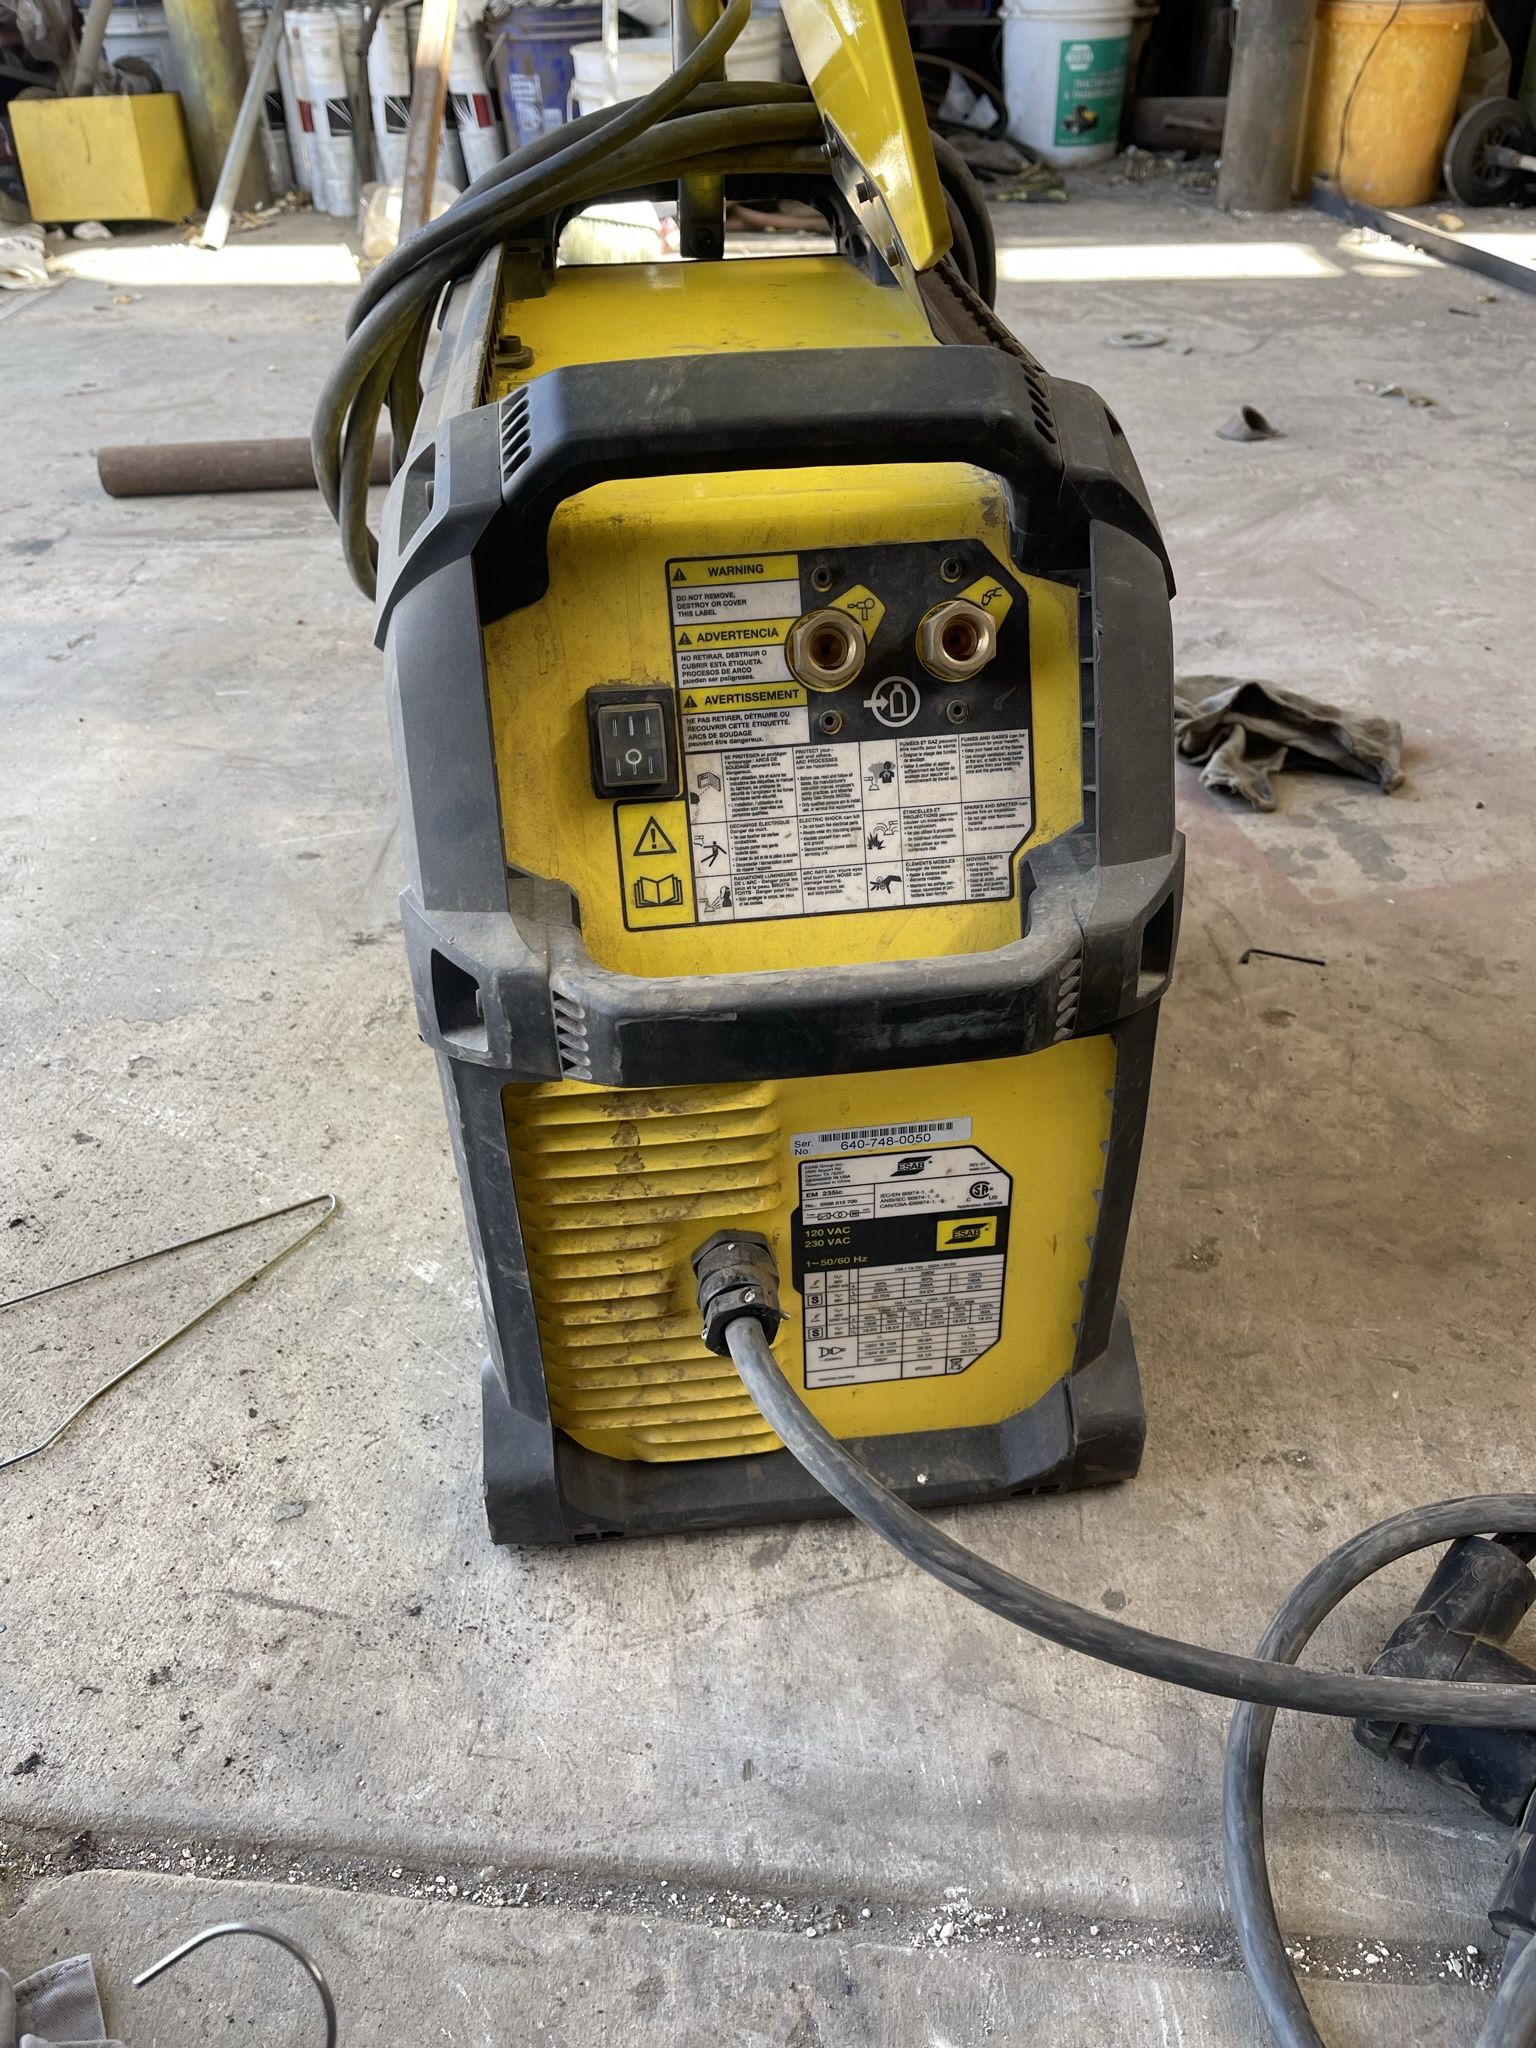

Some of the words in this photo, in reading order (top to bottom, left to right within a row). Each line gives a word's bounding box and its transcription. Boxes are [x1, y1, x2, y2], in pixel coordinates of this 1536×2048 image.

[707, 564, 764, 576] WARNING
[677, 601, 709, 609] DESTROY
[696, 627, 778, 642] ADVERTENCIA
[692, 653, 724, 661] RETIRAR,
[725, 650, 759, 659] DESTRUIR
[728, 658, 762, 666] ETIQUETA.
[682, 669, 719, 677] PROCESOS
[719, 674, 754, 682] peligrosos.
[704, 689, 799, 705] AVERTISSEMENT
[711, 714, 742, 722] RETIRER,
[744, 710, 777, 719] DÉTRUIRE
[687, 724, 726, 732] RECOUVRIR
[794, 1138, 813, 1148] Ser.
[840, 1133, 930, 1150] 640-748-0050
[897, 1161, 924, 1171] ESAB
[805, 1228, 823, 1237] 120
[826, 1226, 850, 1235] VAC
[952, 1229, 980, 1238] ESAB
[804, 1239, 824, 1248] 230
[827, 1236, 850, 1246] VAC
[853, 1254, 867, 1263] Hz
[811, 1296, 819, 1304] S
[811, 1328, 819, 1337] S
